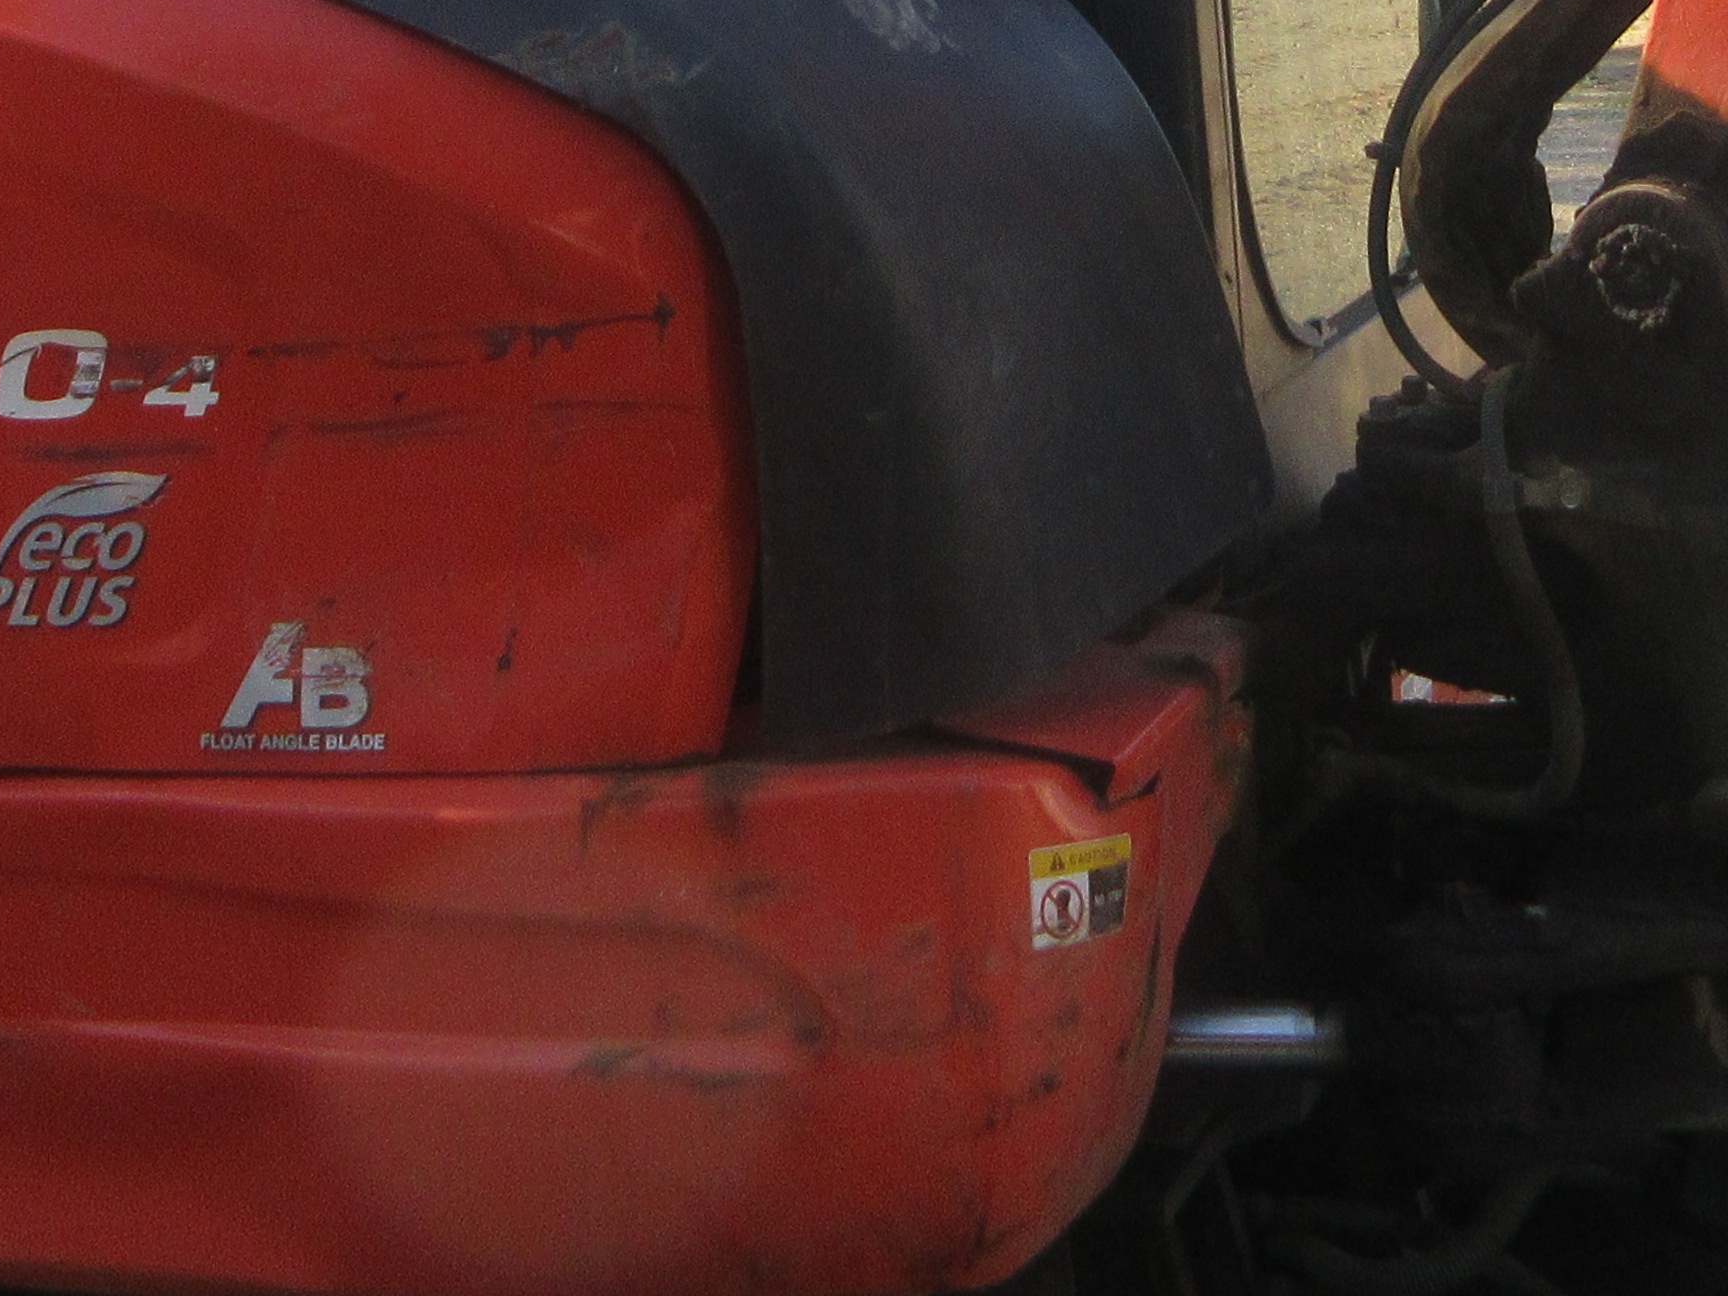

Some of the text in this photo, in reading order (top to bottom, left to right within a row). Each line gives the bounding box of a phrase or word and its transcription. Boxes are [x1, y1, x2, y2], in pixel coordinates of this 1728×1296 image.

[19, 521, 145, 571] eco
[199, 732, 386, 750] FLOAT ANGLE BLADE
